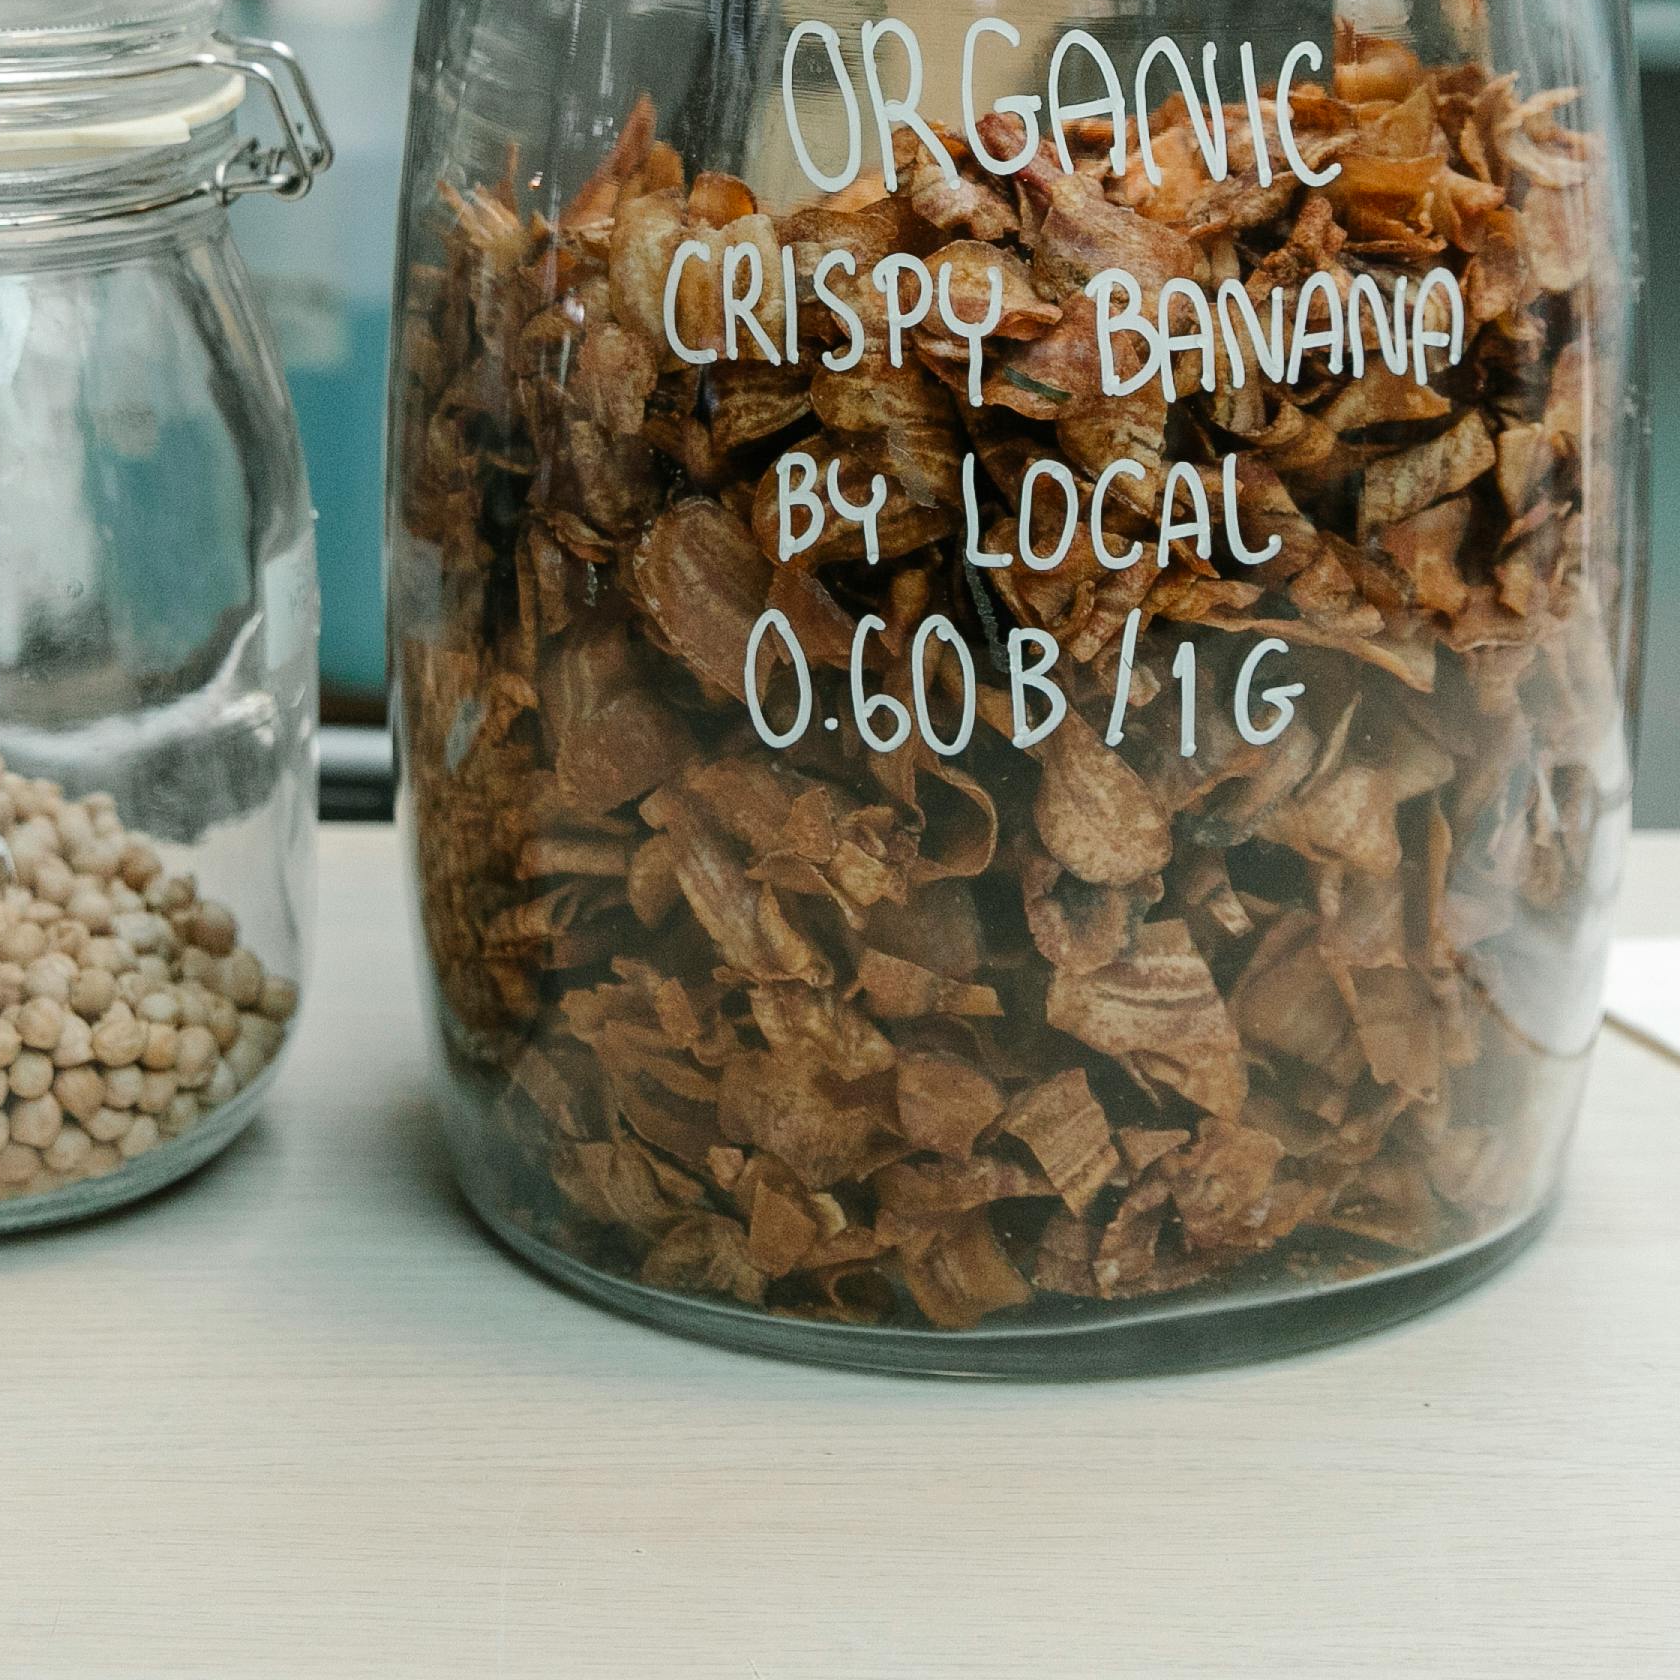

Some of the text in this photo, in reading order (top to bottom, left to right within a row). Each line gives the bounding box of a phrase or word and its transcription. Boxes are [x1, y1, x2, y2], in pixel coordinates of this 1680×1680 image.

[781, 15, 1343, 194] ORGANIC
[662, 240, 1466, 407] CRISPY BANANA
[775, 451, 1283, 571] BY LOCAL
